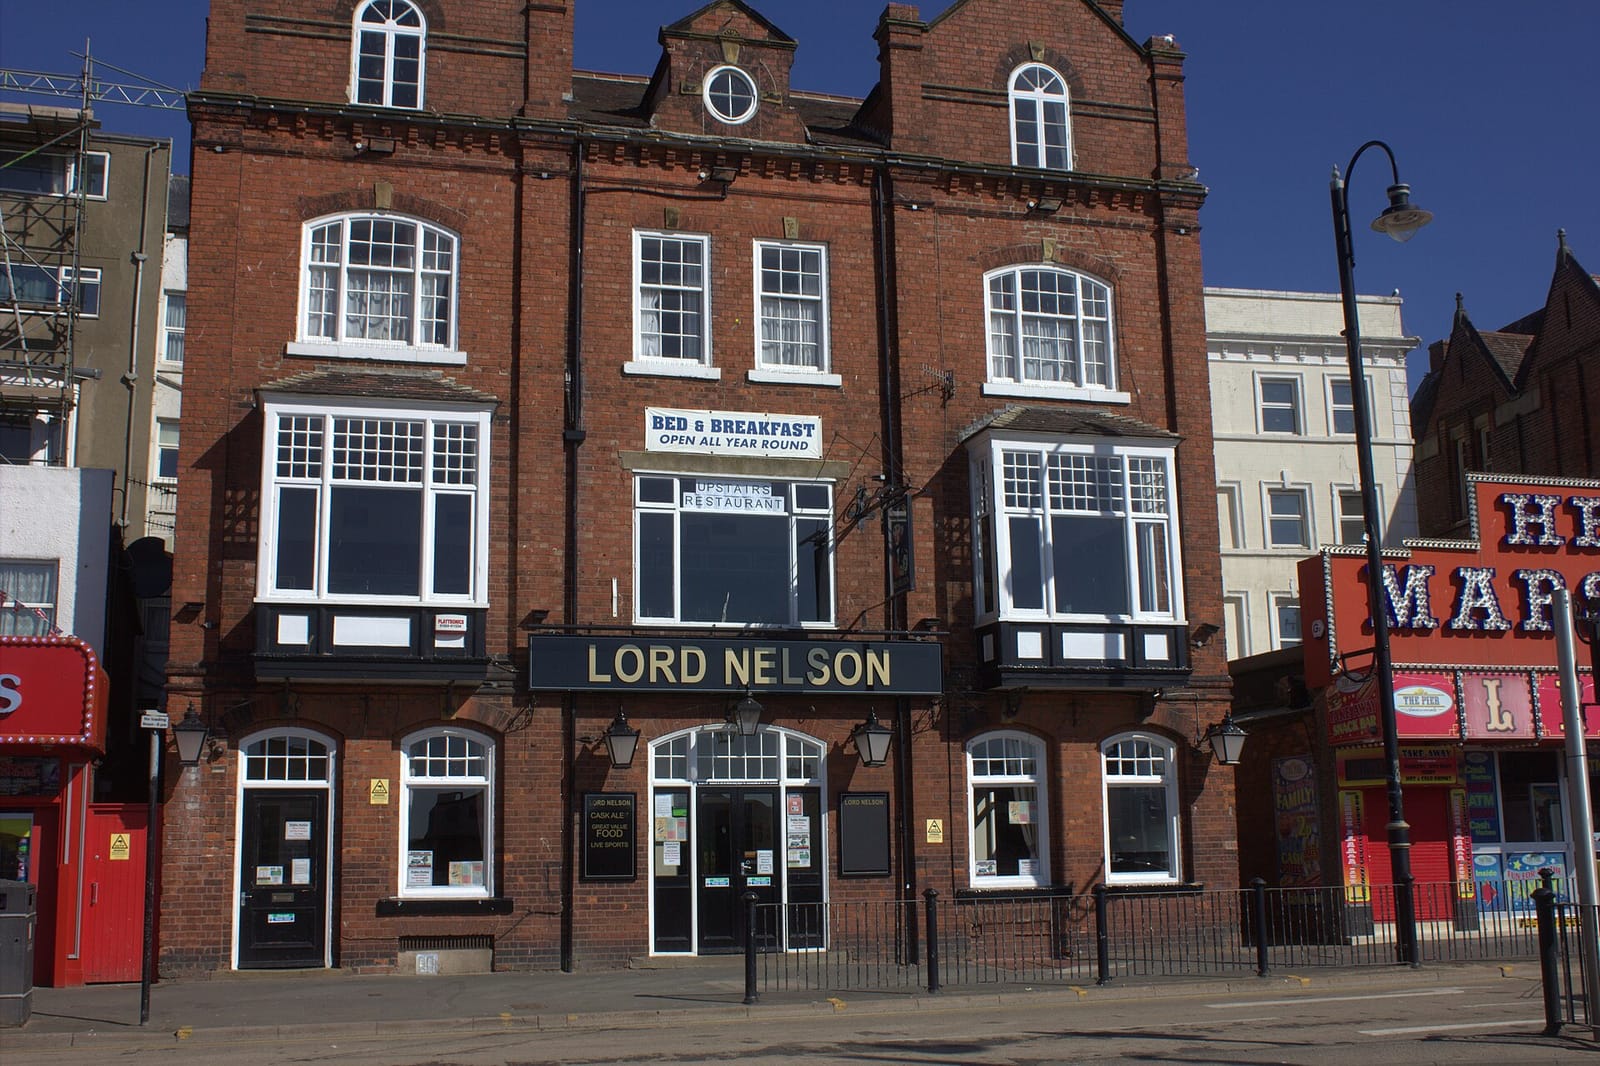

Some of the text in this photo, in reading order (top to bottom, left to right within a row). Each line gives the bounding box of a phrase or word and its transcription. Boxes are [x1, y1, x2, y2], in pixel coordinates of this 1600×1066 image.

[652, 415, 815, 437] BED & BREAKFAST
[659, 434, 809, 450] OPEN ALL YEAR ROUND
[697, 482, 770, 494] UPSTAIRS
[685, 496, 782, 509] RESTAURANT
[588, 644, 891, 686] LORD NELSON
[1403, 695, 1440, 706] THE PIER
[1482, 678, 1516, 733] L
[606, 799, 631, 807] NELSON
[1470, 793, 1494, 807] ATM
[596, 829, 624, 838] FOOD
[1507, 870, 1521, 880] FUN
[1521, 871, 1535, 880] FOR
